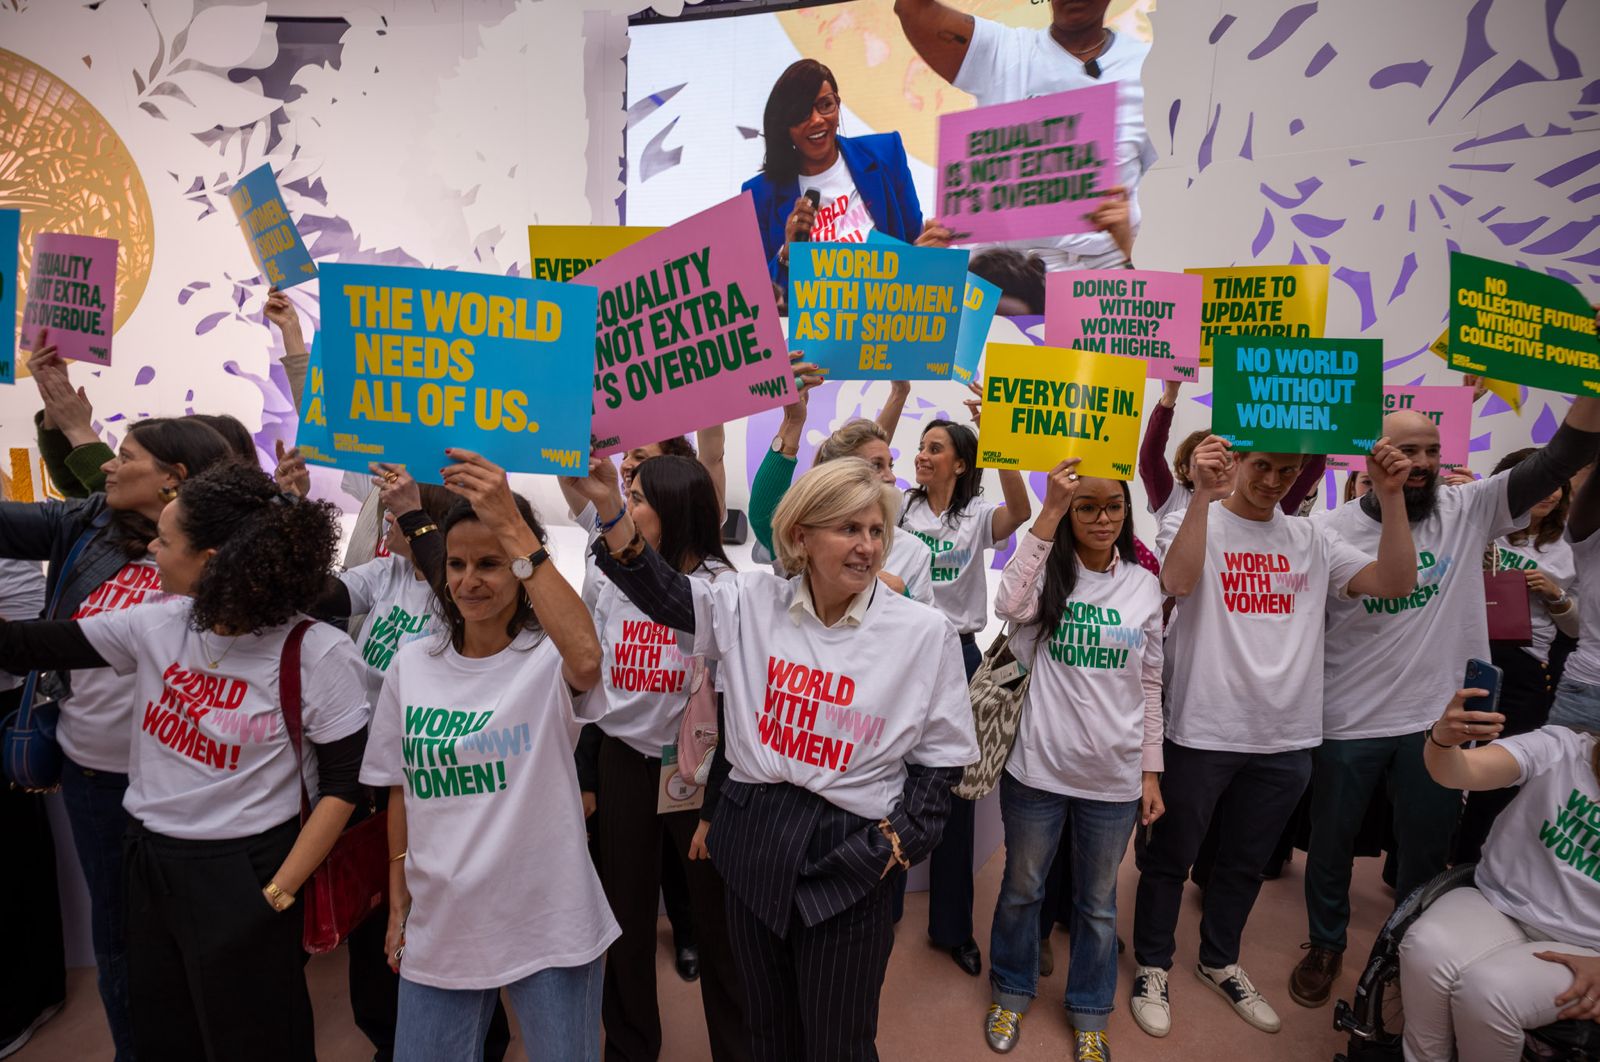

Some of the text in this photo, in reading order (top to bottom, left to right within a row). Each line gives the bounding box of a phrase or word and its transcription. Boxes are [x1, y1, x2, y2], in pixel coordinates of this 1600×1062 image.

[816, 195, 849, 231] ORLD
[811, 248, 899, 280] WORLD
[54, 279, 106, 312] EXTRA,
[597, 246, 710, 332] QUALITY
[794, 278, 859, 310] WITH
[864, 282, 958, 314] WOMEN.
[1073, 279, 1147, 298] DOING IT
[1214, 276, 1296, 299] TIME TO
[1485, 276, 1507, 296] NO
[343, 284, 563, 343] THE WORLD
[648, 282, 760, 351] EXTRA,
[1100, 299, 1175, 319] WITHOUT
[1202, 300, 1283, 323] UPDATE
[1458, 288, 1542, 323] COLLECTIVE
[795, 309, 947, 342] AS IT SHOULD
[1081, 318, 1160, 338] WOMEN?
[1476, 310, 1542, 340] WITHOUT
[355, 333, 475, 382] NEEDS
[858, 343, 892, 371] BE.
[1072, 336, 1175, 359] AIM HIGHER.
[1460, 325, 1544, 360] COLLECTIVE
[625, 323, 772, 401] OVERDUE.
[1237, 347, 1358, 375] NO WORLD
[749, 375, 788, 399] WWW!
[987, 376, 1139, 418] EVERYONE IN.
[1248, 374, 1356, 404] WITHOUT
[1400, 393, 1415, 408] IT
[350, 379, 411, 424] ALL
[417, 383, 466, 427] OF
[474, 387, 540, 433] US.
[1236, 403, 1338, 431] WOMEN.
[1011, 406, 1110, 442] FINALLY.
[1224, 552, 1290, 573] WORLD
[1499, 548, 1538, 571] ORLD
[116, 563, 161, 591] ORL
[1220, 572, 1271, 593] WITH
[1224, 592, 1295, 614] WOMEN!
[615, 643, 662, 668] WITH
[1049, 640, 1129, 669] WOMEN!
[162, 661, 248, 710] WORLD
[611, 666, 686, 693] WOMEN!
[768, 656, 856, 706] WORLD
[405, 705, 494, 737] WORLD
[764, 682, 820, 731] WITH
[142, 701, 242, 771] WOMEN!
[402, 735, 458, 767] WITH
[755, 711, 855, 773] WOMEN!
[402, 760, 507, 800] WOMEN!
